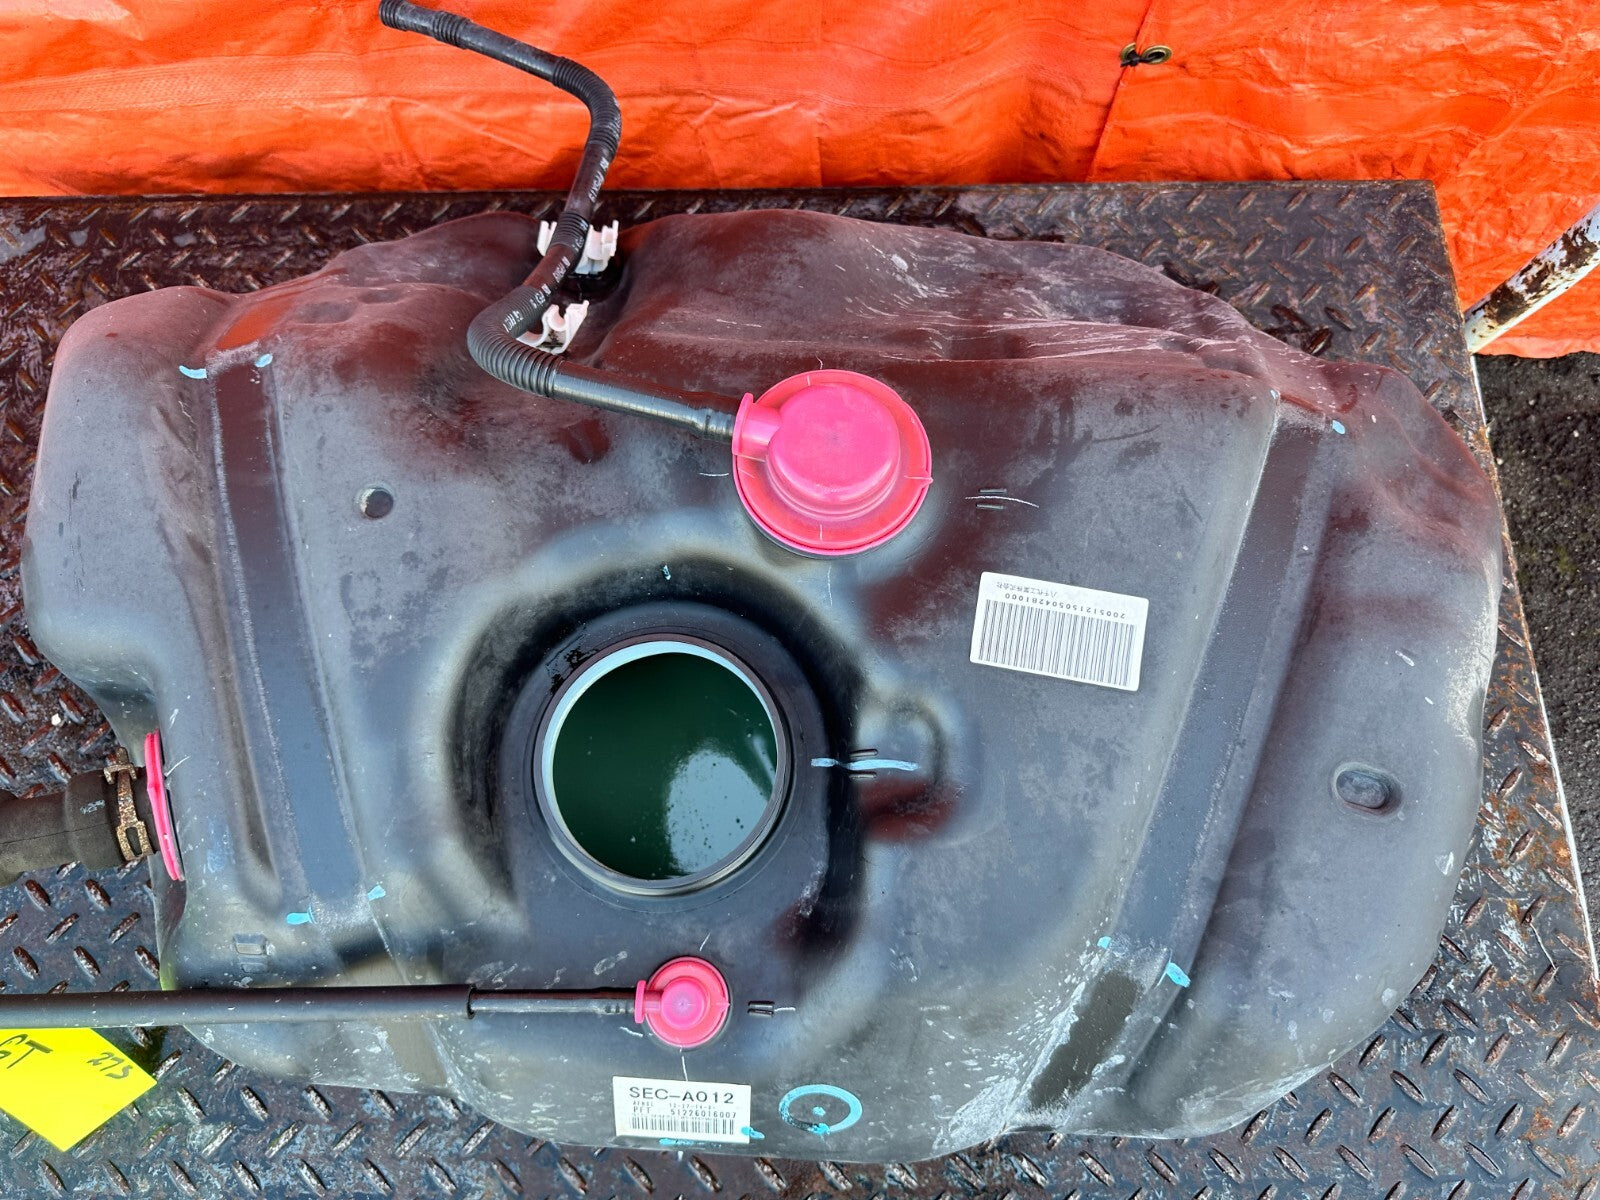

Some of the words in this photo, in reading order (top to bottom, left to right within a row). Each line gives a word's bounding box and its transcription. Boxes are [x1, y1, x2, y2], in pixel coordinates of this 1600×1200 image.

[996, 581, 1058, 598] 八千代工業株式会社
[1004, 592, 1126, 619] 2005121505042B1000
